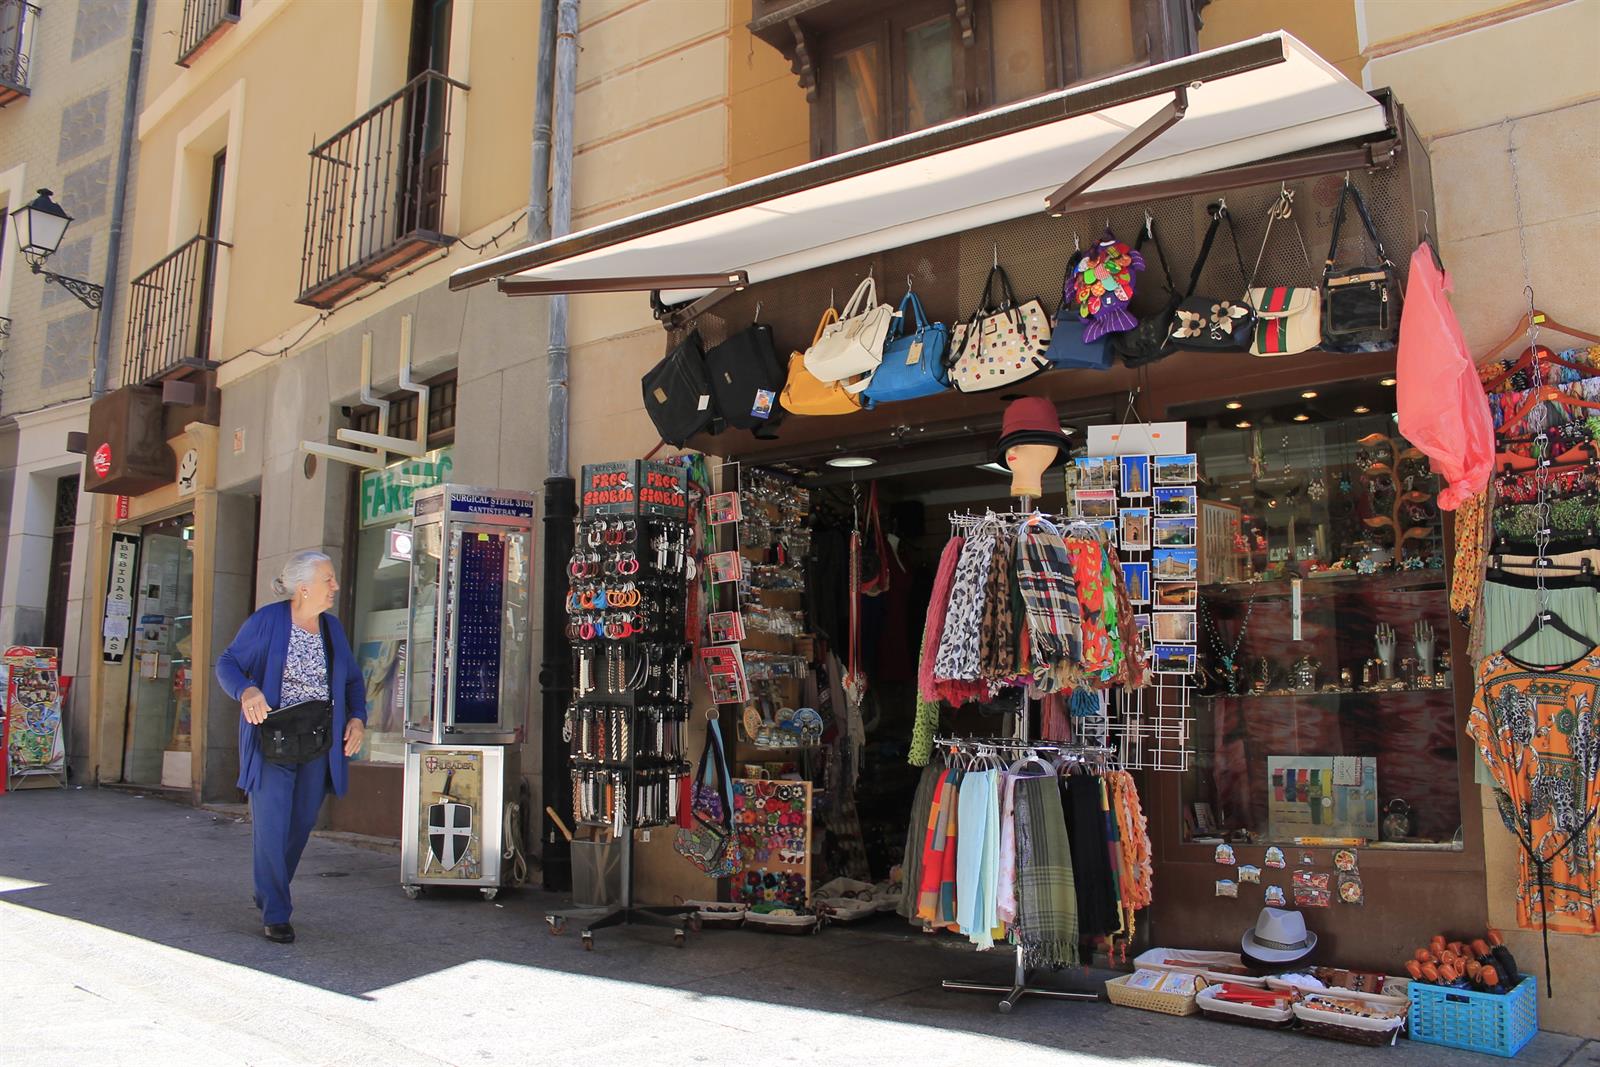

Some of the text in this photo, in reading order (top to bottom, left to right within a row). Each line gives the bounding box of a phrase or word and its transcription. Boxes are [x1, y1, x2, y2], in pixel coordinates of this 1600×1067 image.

[451, 494, 489, 504] SURGICAL
[490, 498, 514, 507] STEEL
[468, 505, 517, 516] SANTISTEBAN
[115, 544, 129, 600] BEBIDAS
